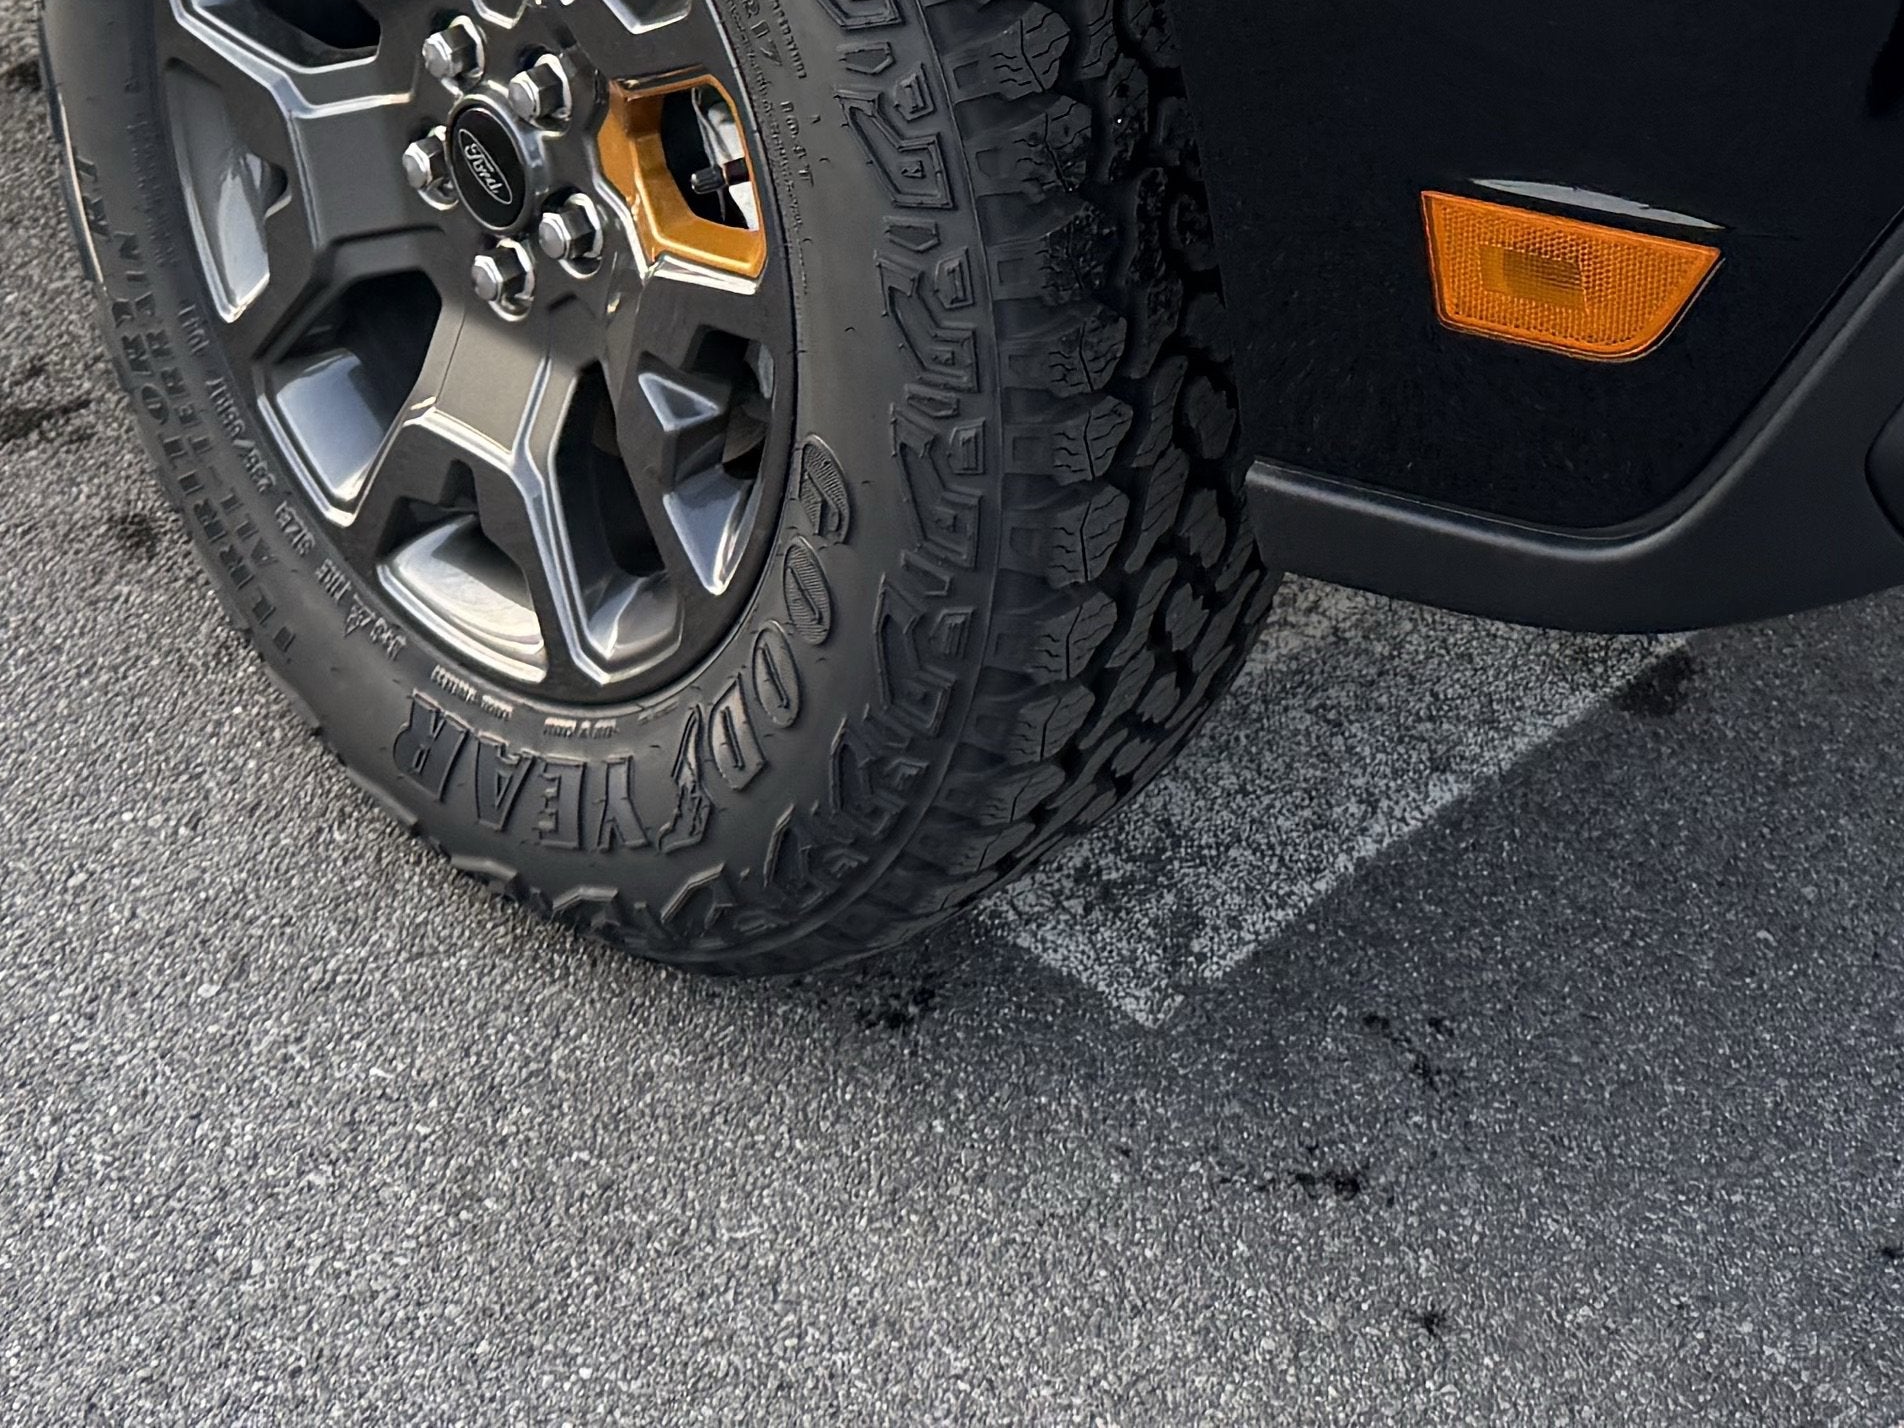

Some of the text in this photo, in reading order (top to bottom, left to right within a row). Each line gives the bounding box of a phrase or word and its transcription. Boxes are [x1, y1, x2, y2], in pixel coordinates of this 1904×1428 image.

[463, 143, 504, 194] Ford
[111, 230, 279, 568] ALL-TERRAIN
[392, 432, 850, 854] GOODYEAR
